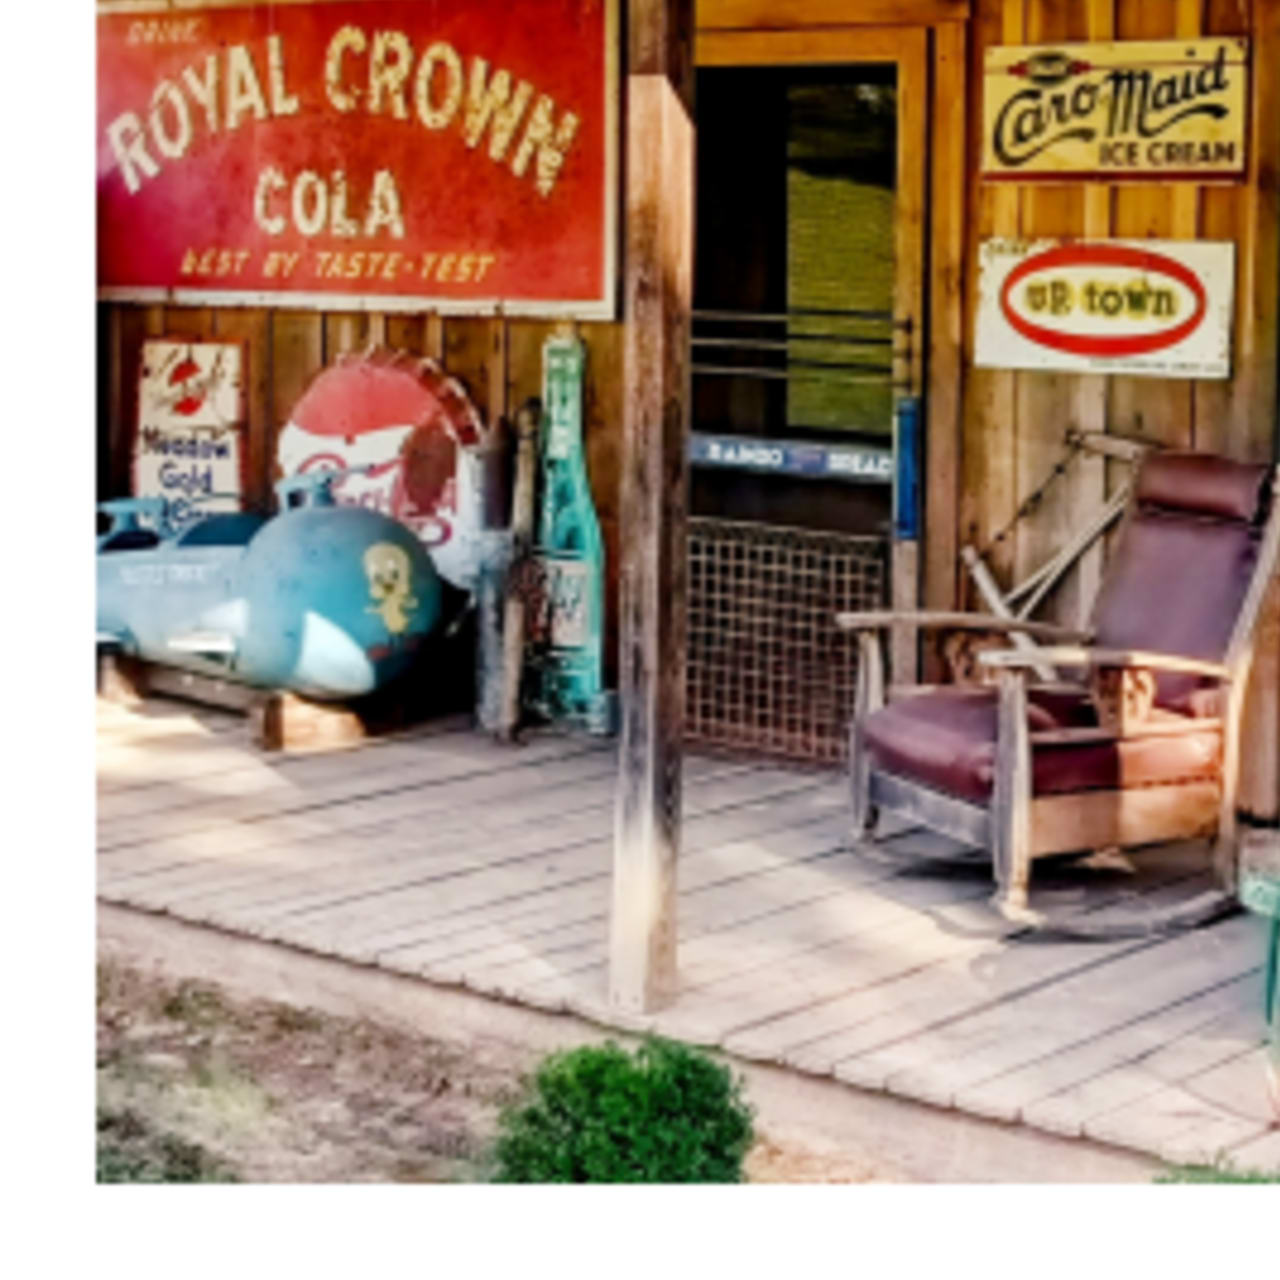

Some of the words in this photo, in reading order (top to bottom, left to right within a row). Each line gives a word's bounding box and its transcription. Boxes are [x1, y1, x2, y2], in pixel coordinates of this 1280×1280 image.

[106, 35, 300, 195] ROYAL
[324, 24, 581, 197] CROWN
[1099, 45, 1230, 140] Maid
[1099, 142, 1139, 166] ICE
[1146, 141, 1236, 166] CREAM
[253, 164, 405, 239] COLA
[180, 247, 251, 275] BEST
[263, 251, 300, 278] BY
[158, 463, 214, 495] Gold
